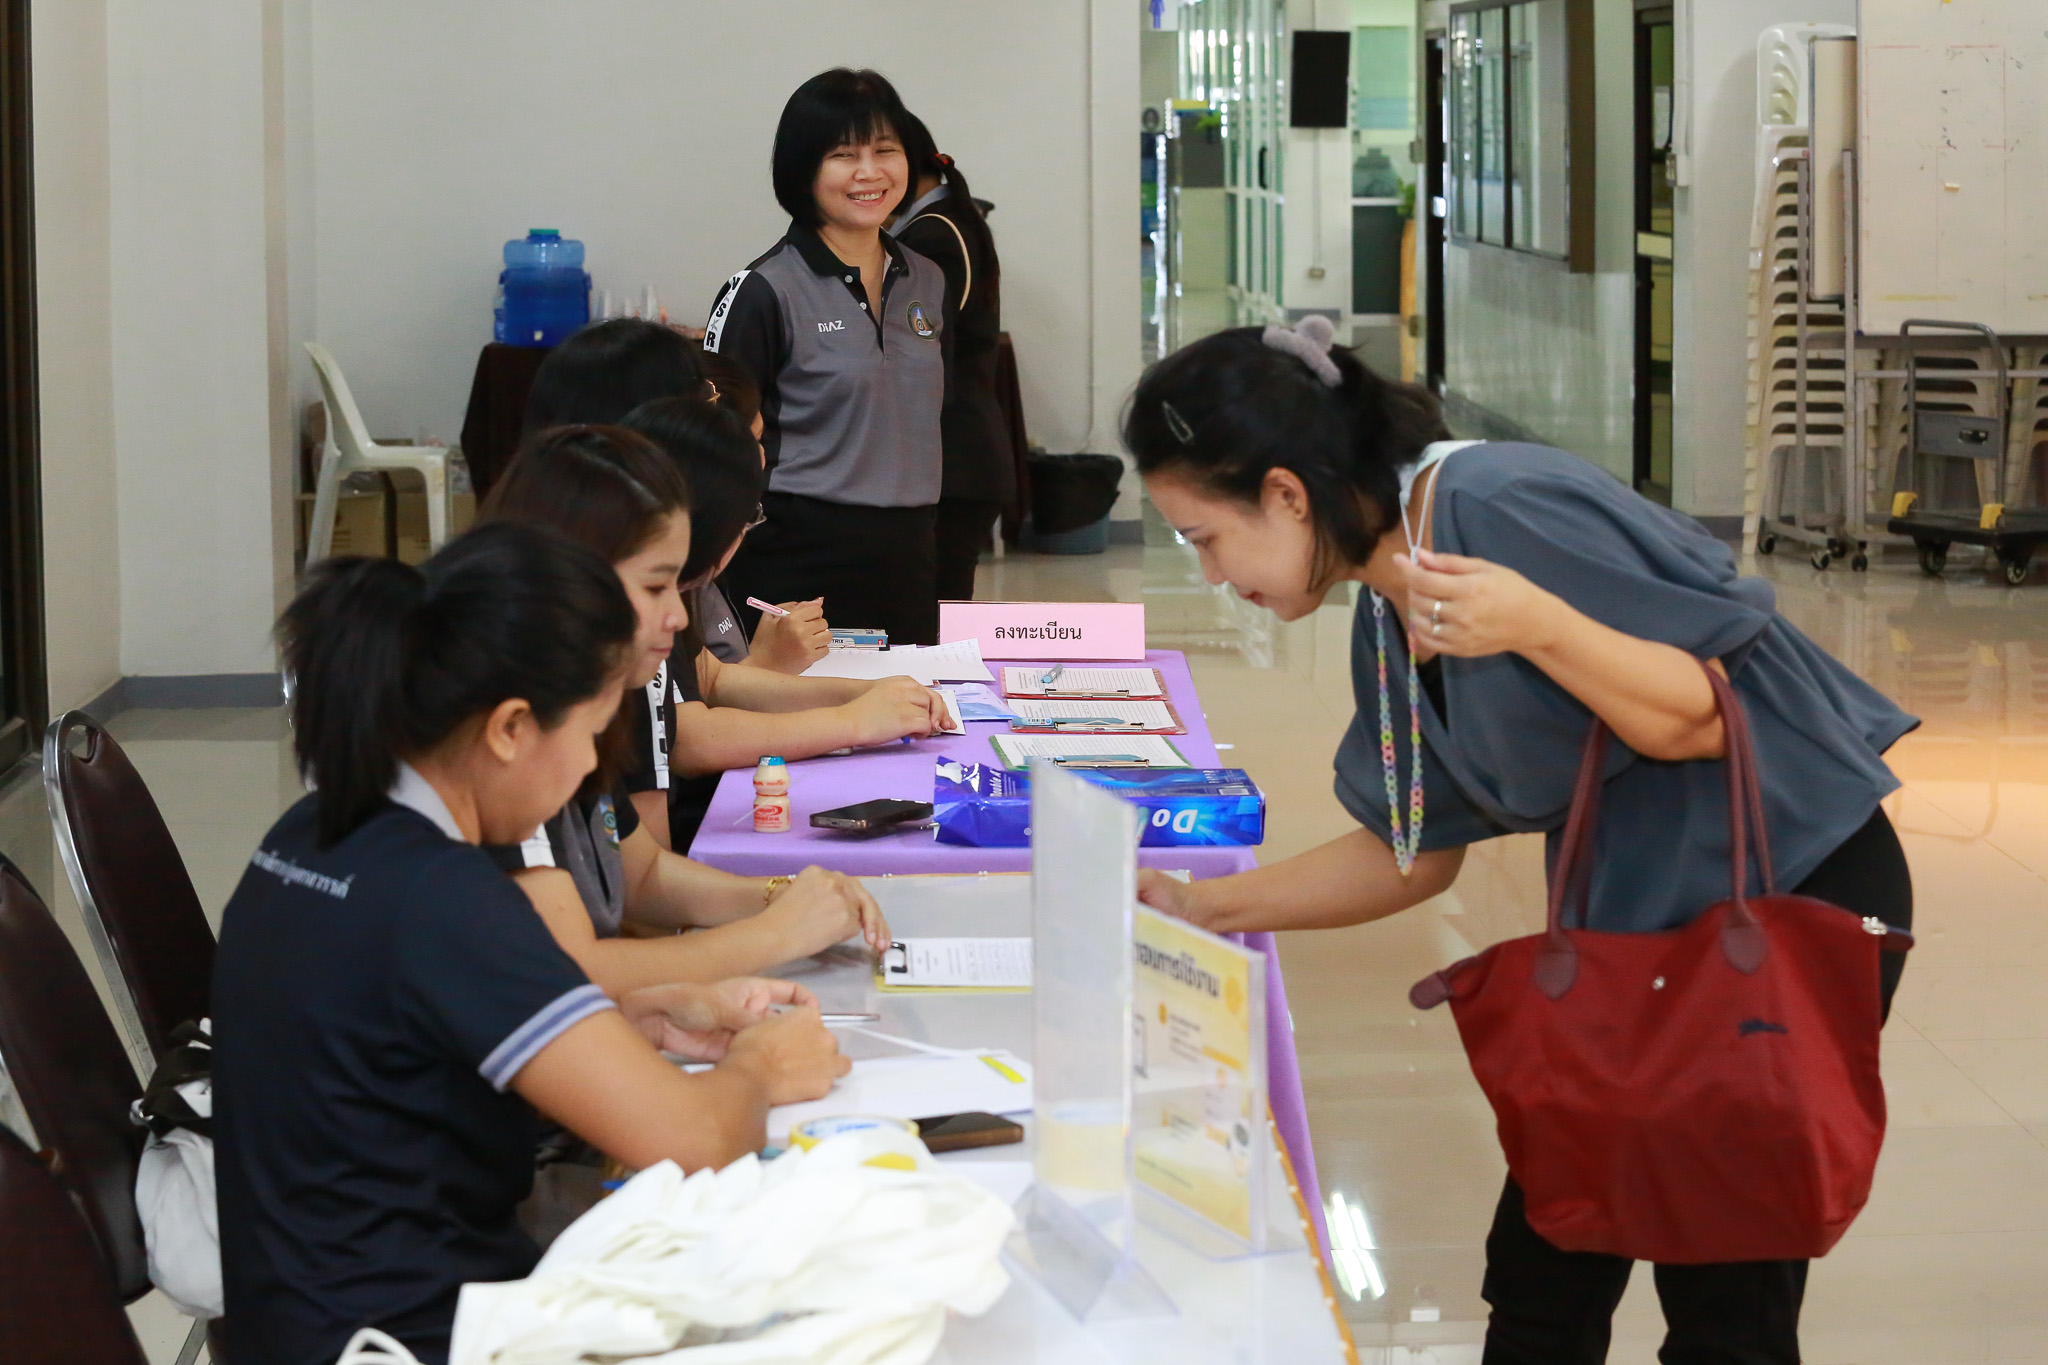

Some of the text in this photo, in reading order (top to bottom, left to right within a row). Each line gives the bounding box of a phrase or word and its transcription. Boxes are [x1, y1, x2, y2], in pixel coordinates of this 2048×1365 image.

[994, 620, 1082, 640] ลงทะเบียน
[1151, 808, 1199, 834] Do
